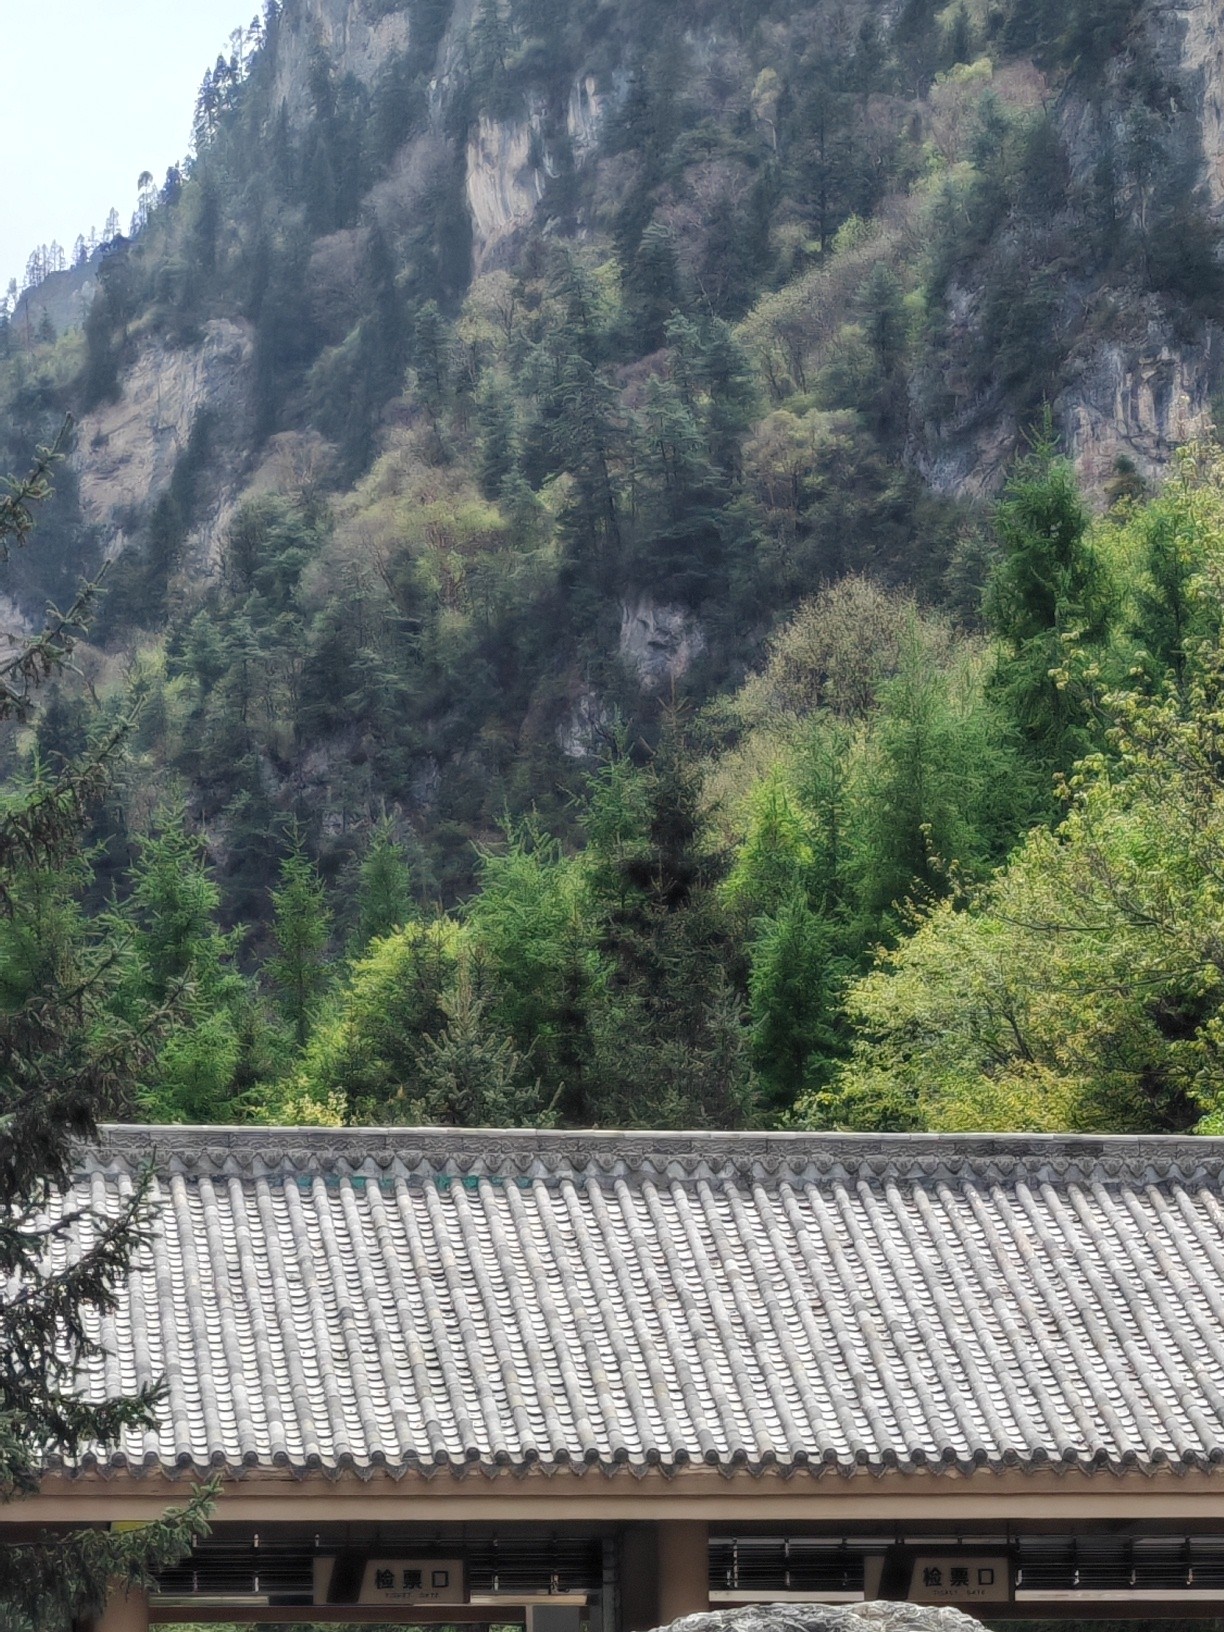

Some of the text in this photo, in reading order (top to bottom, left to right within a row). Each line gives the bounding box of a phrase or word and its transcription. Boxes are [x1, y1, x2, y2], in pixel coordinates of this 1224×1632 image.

[375, 1569, 449, 1590] 检票口
[923, 1567, 994, 1587] 检票口
